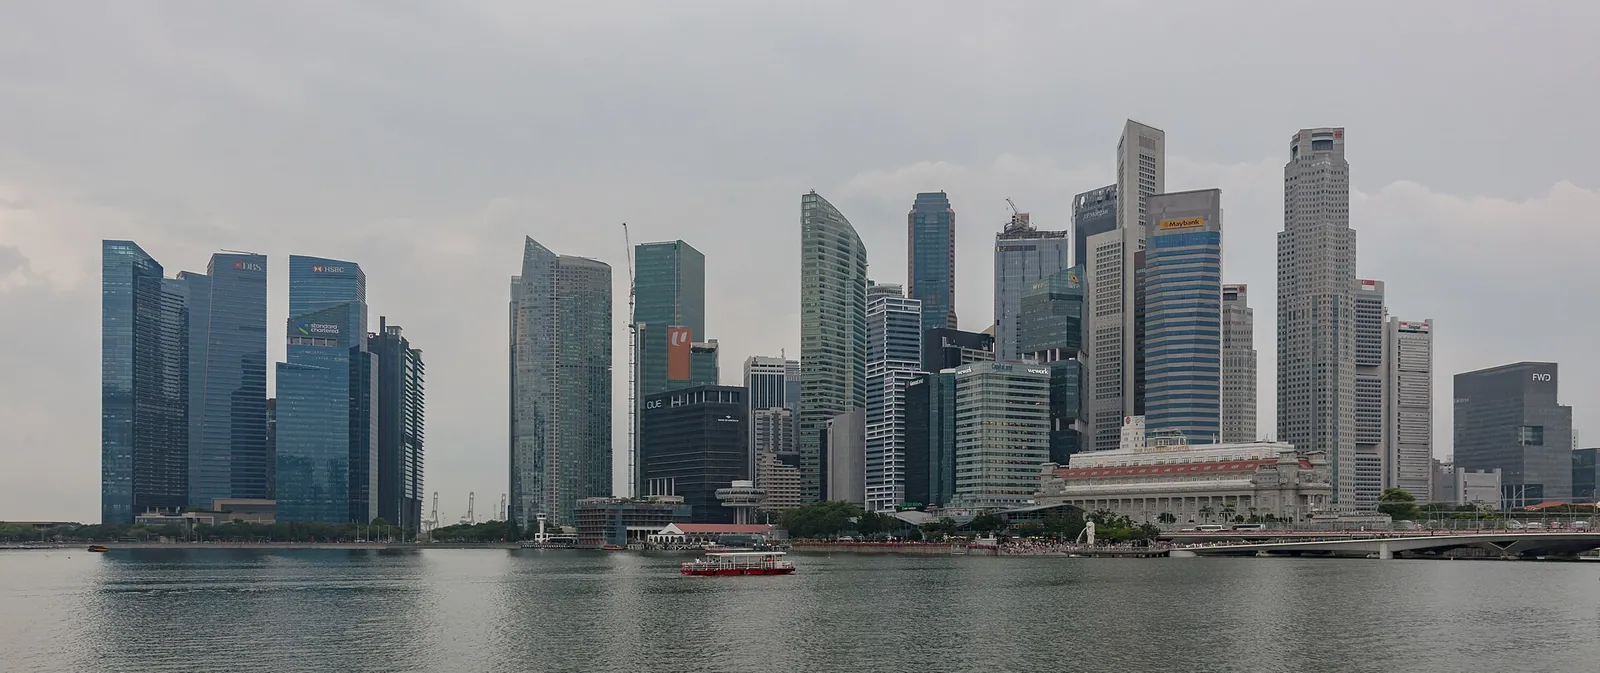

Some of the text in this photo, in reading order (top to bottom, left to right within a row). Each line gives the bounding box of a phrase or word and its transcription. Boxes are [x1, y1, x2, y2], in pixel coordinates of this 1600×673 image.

[1169, 219, 1200, 228] Maybank
[242, 262, 262, 271] DBS
[1027, 367, 1049, 375] wework
[1532, 373, 1551, 382] FWD
[647, 399, 662, 409] OUE
